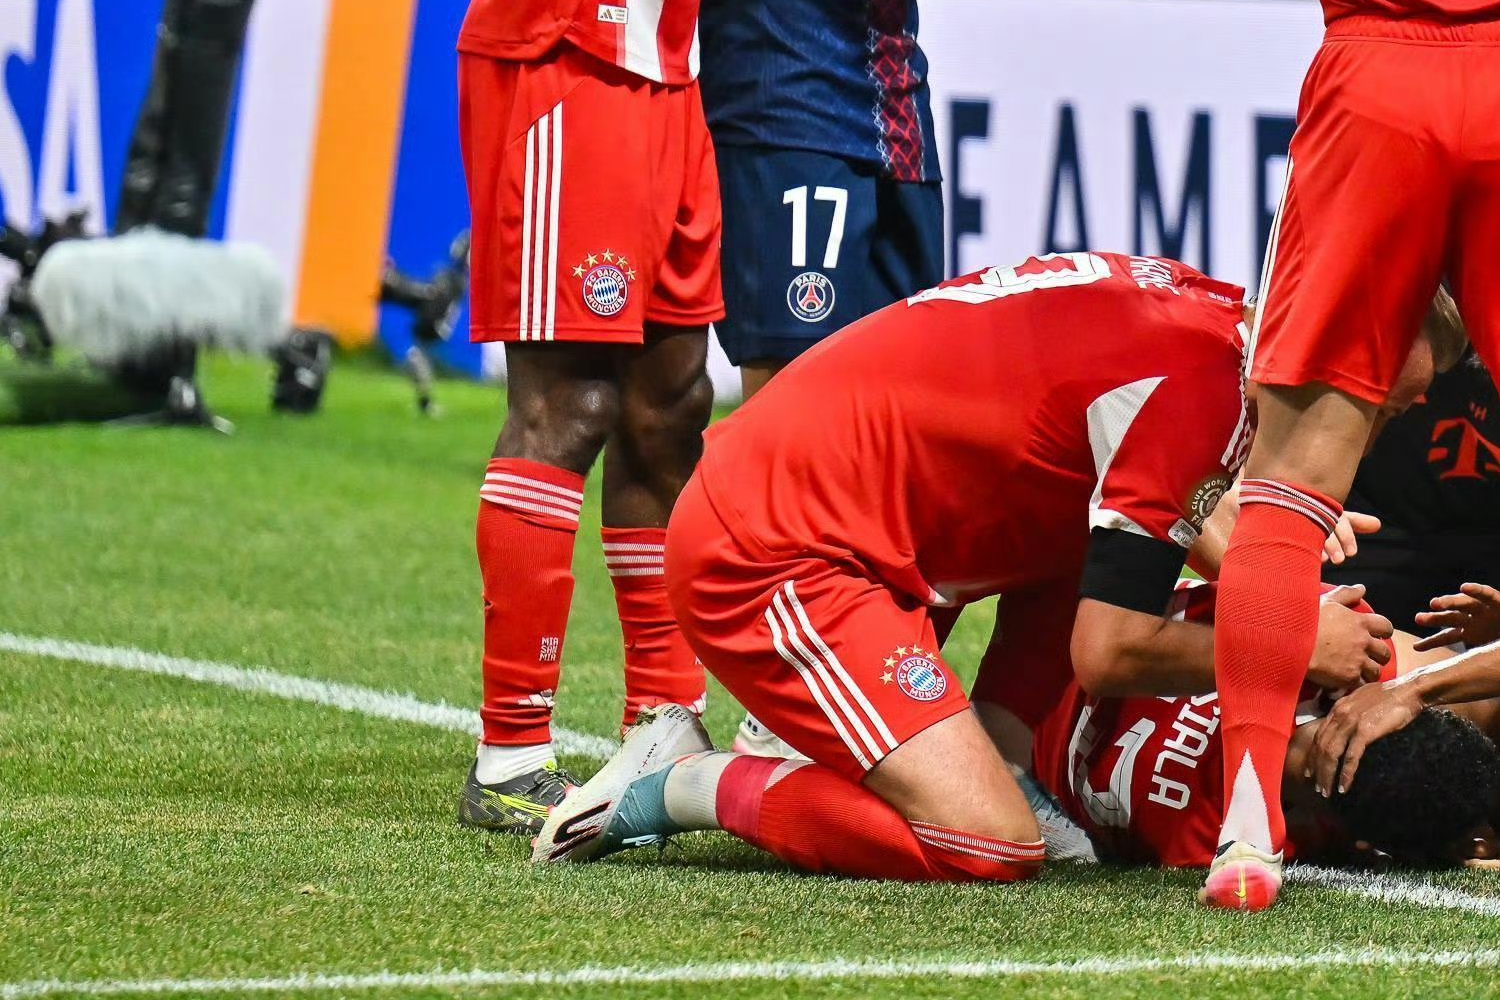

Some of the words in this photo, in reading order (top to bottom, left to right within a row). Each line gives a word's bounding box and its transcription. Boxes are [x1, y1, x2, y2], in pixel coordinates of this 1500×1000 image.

[783, 186, 848, 268] 17
[597, 269, 625, 289] BAYERN
[795, 274, 828, 288] PARIS
[1191, 489, 1204, 510] CLUB
[541, 636, 559, 646] MIA
[540, 645, 558, 654] SAN
[539, 652, 556, 662] MIA
[902, 659, 935, 672] BAYERN
